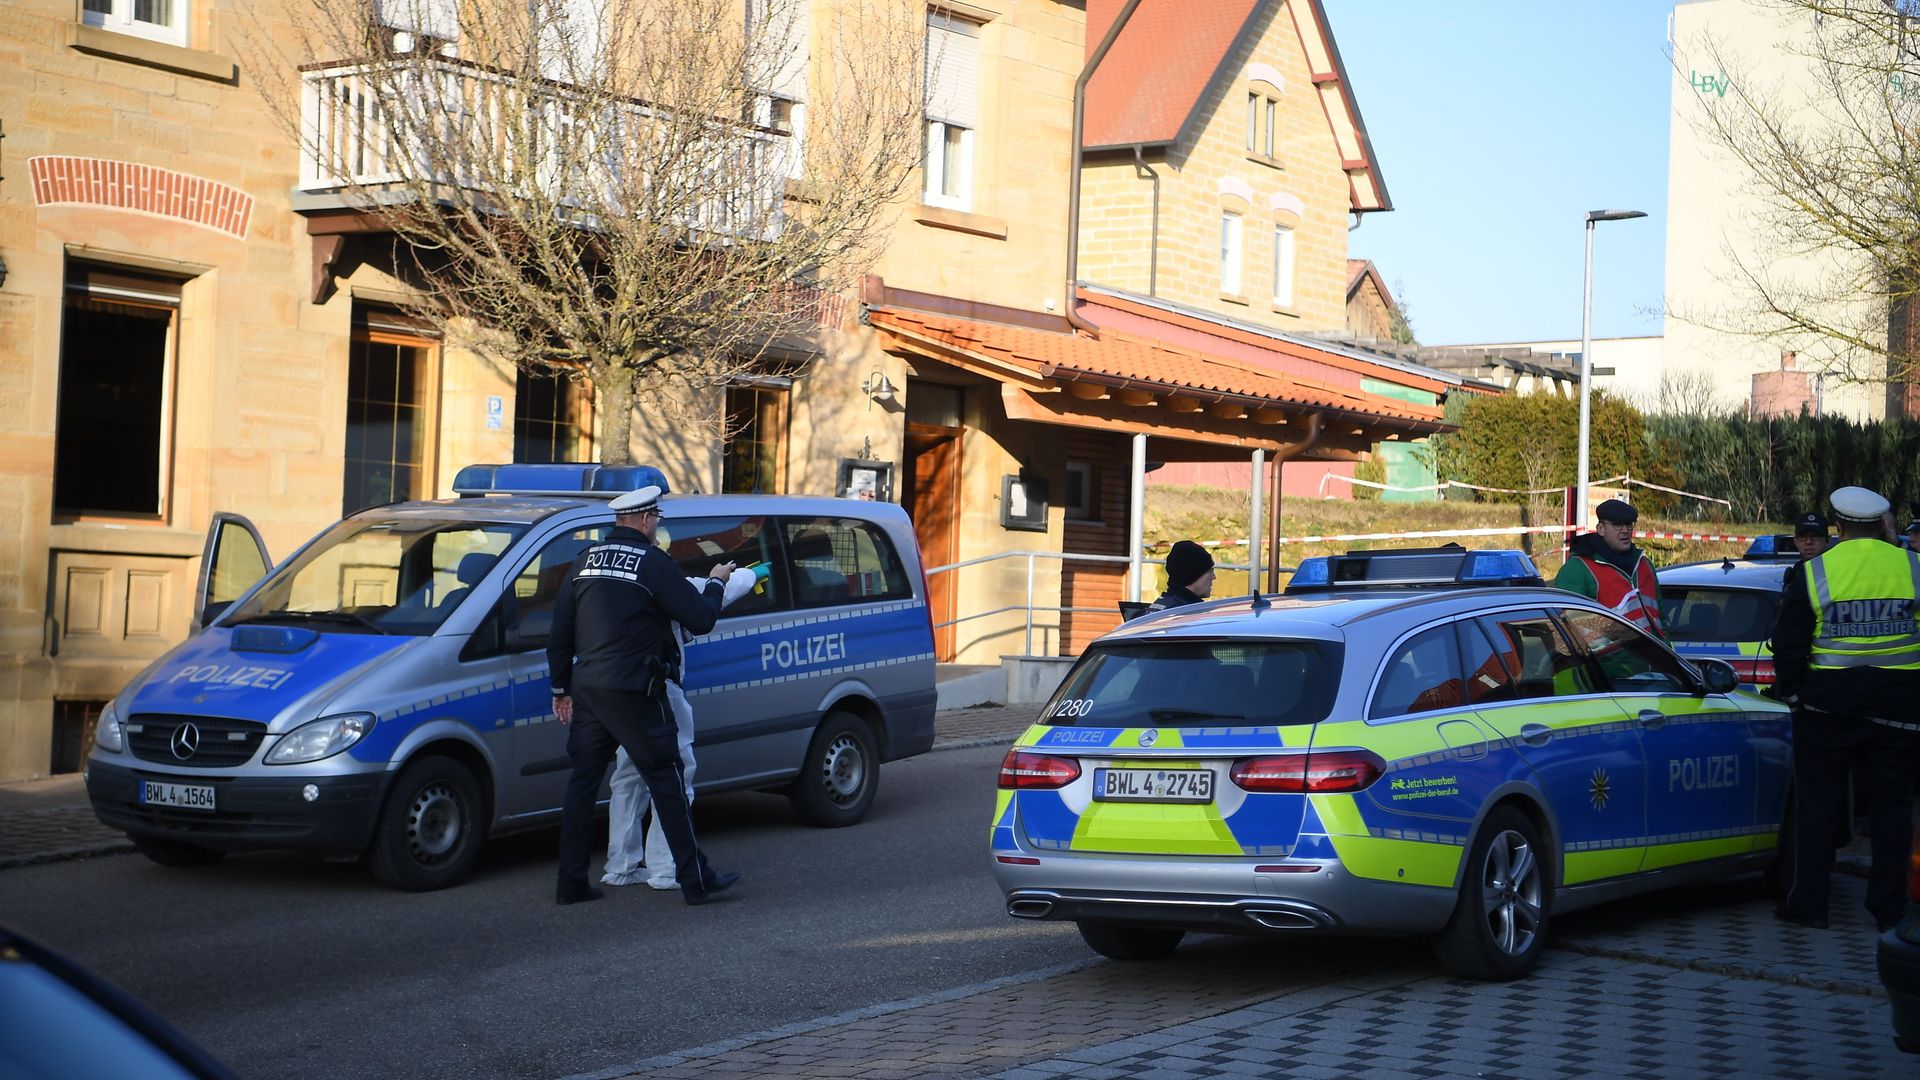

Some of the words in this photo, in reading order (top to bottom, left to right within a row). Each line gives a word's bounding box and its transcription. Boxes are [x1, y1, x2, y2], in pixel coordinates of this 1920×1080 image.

[1691, 70, 1729, 97] LBV
[491, 399, 500, 415] P
[585, 552, 641, 572] POLIZEI
[1830, 620, 1915, 637] EINSATZLEITER
[761, 632, 846, 671] POLIZEI
[168, 665, 295, 690] POLIZEI
[1051, 728, 1105, 744] POLIZEI
[1406, 778, 1423, 789] Jetzt
[1423, 776, 1458, 787] bewerben!
[1668, 754, 1740, 793] POLIZEI
[1106, 773, 1139, 795] BWL
[1143, 773, 1153, 795] 4
[1166, 774, 1210, 796] 2745
[1392, 787, 1459, 801] www.polizei-der-beruf.de
[146, 784, 167, 803] BWL
[169, 786, 176, 803] 4
[184, 788, 213, 807] 1564
